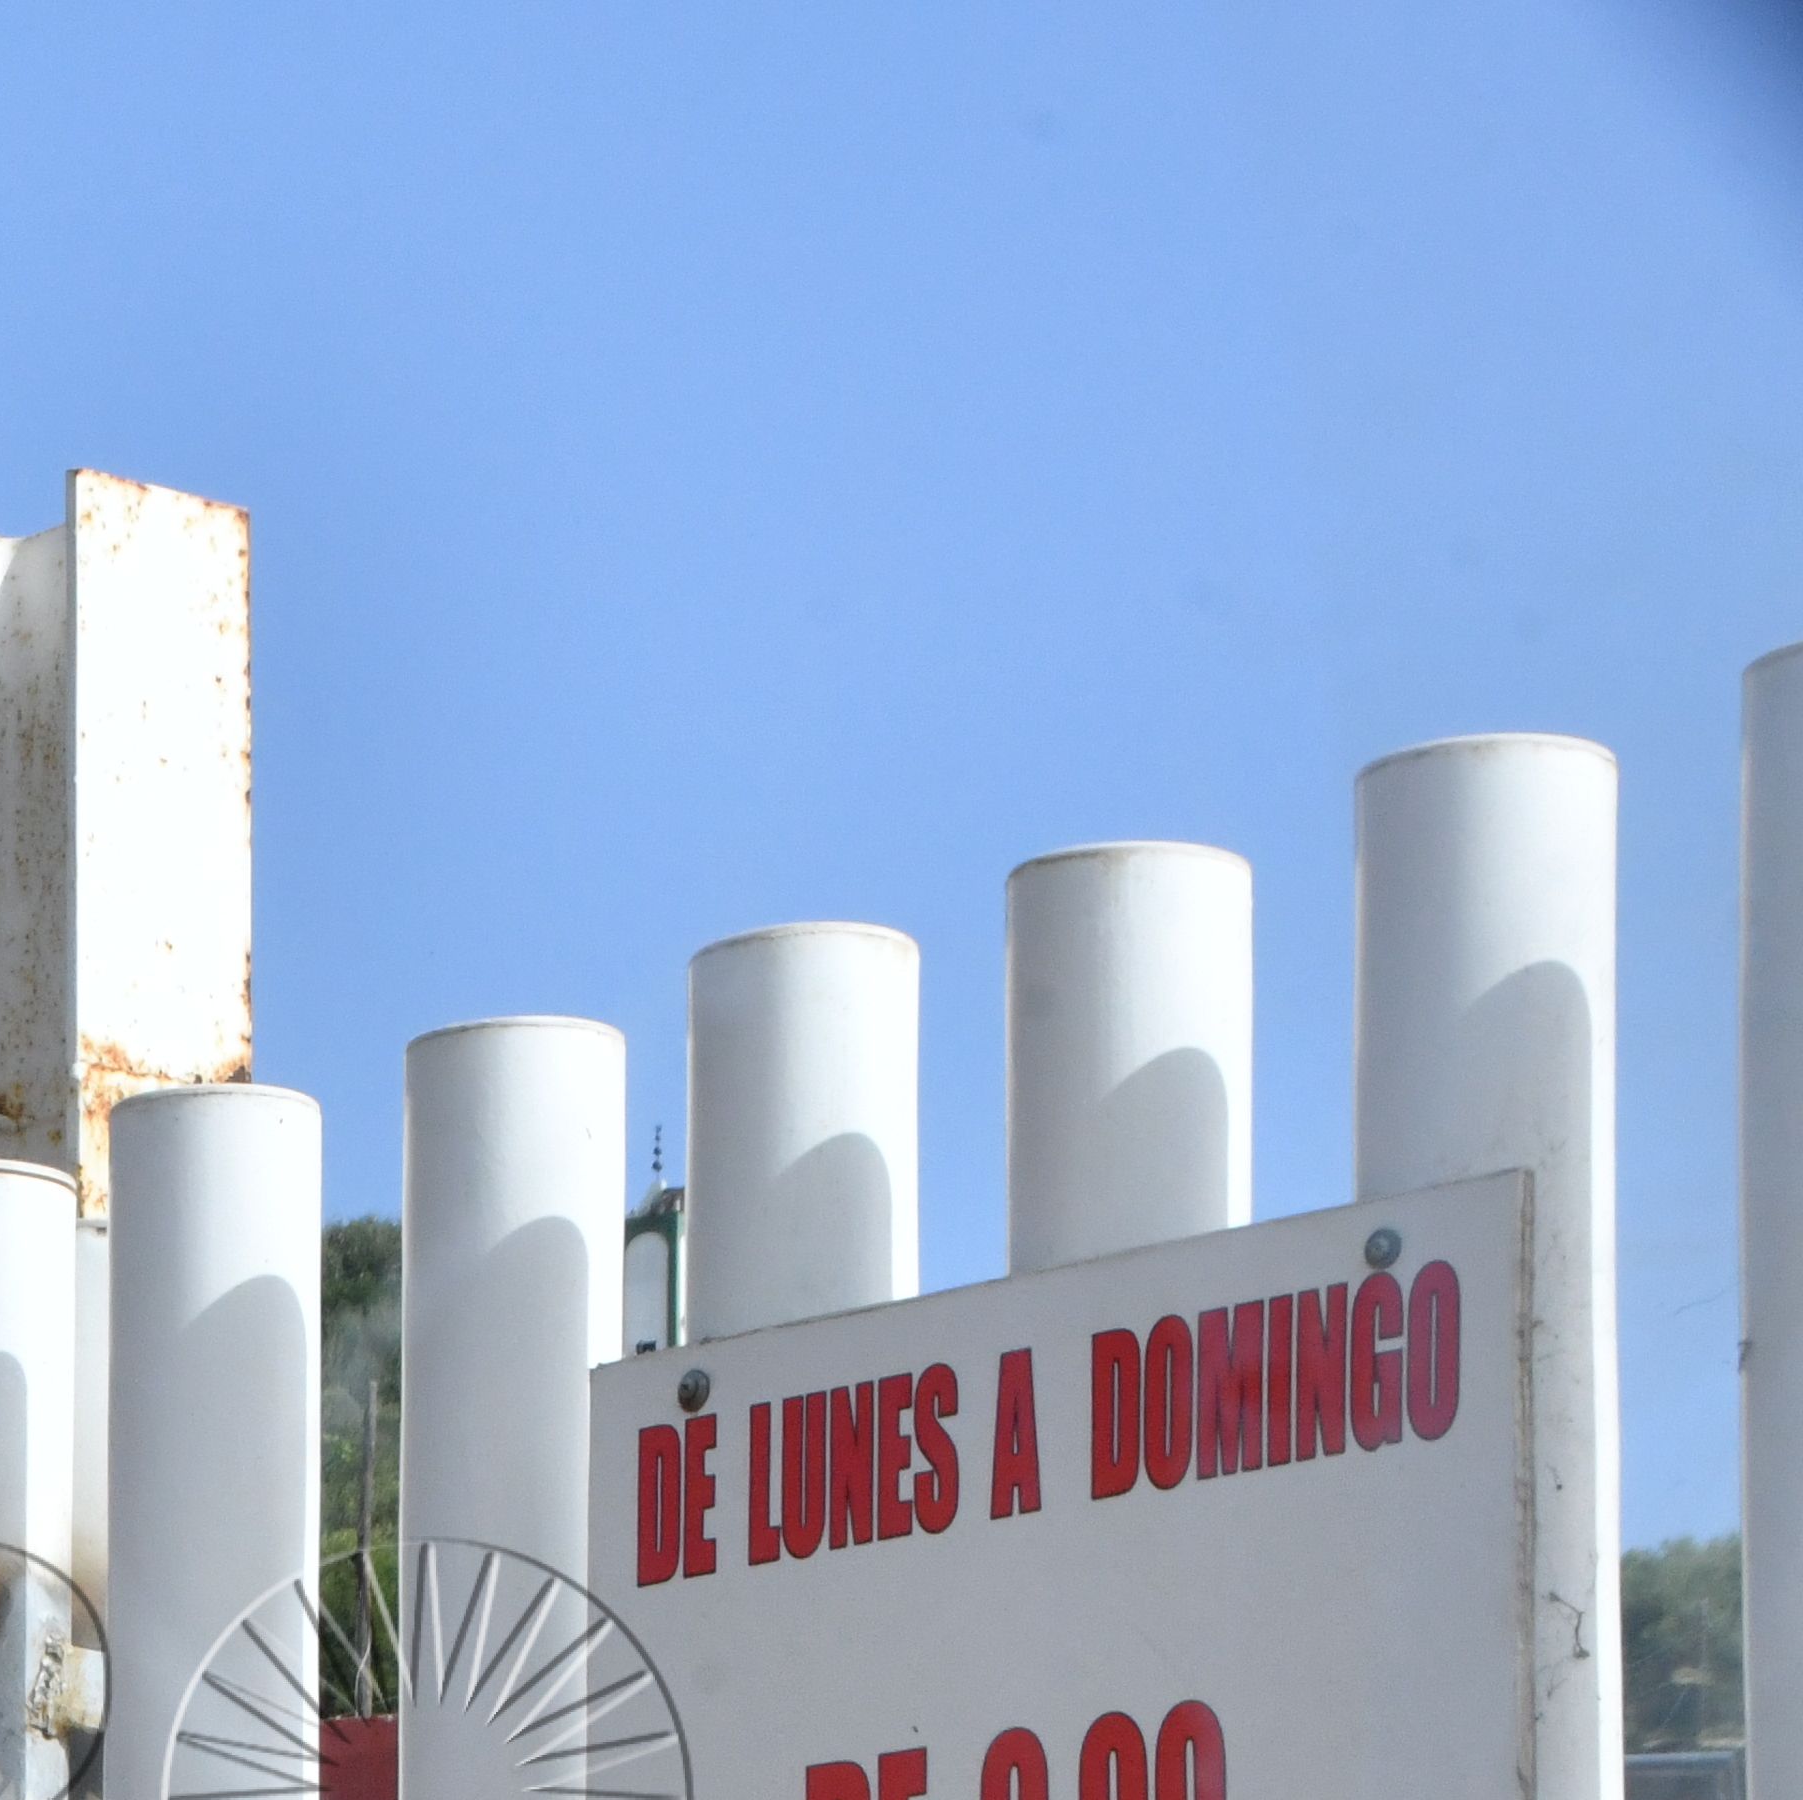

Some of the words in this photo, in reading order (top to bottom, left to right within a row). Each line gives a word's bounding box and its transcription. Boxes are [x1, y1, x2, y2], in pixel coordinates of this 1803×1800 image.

[636, 1414, 717, 1586] DE
[748, 1363, 960, 1565] LUNES
[990, 1349, 1041, 1519] A
[1090, 1258, 1460, 1500] DOMINGO
